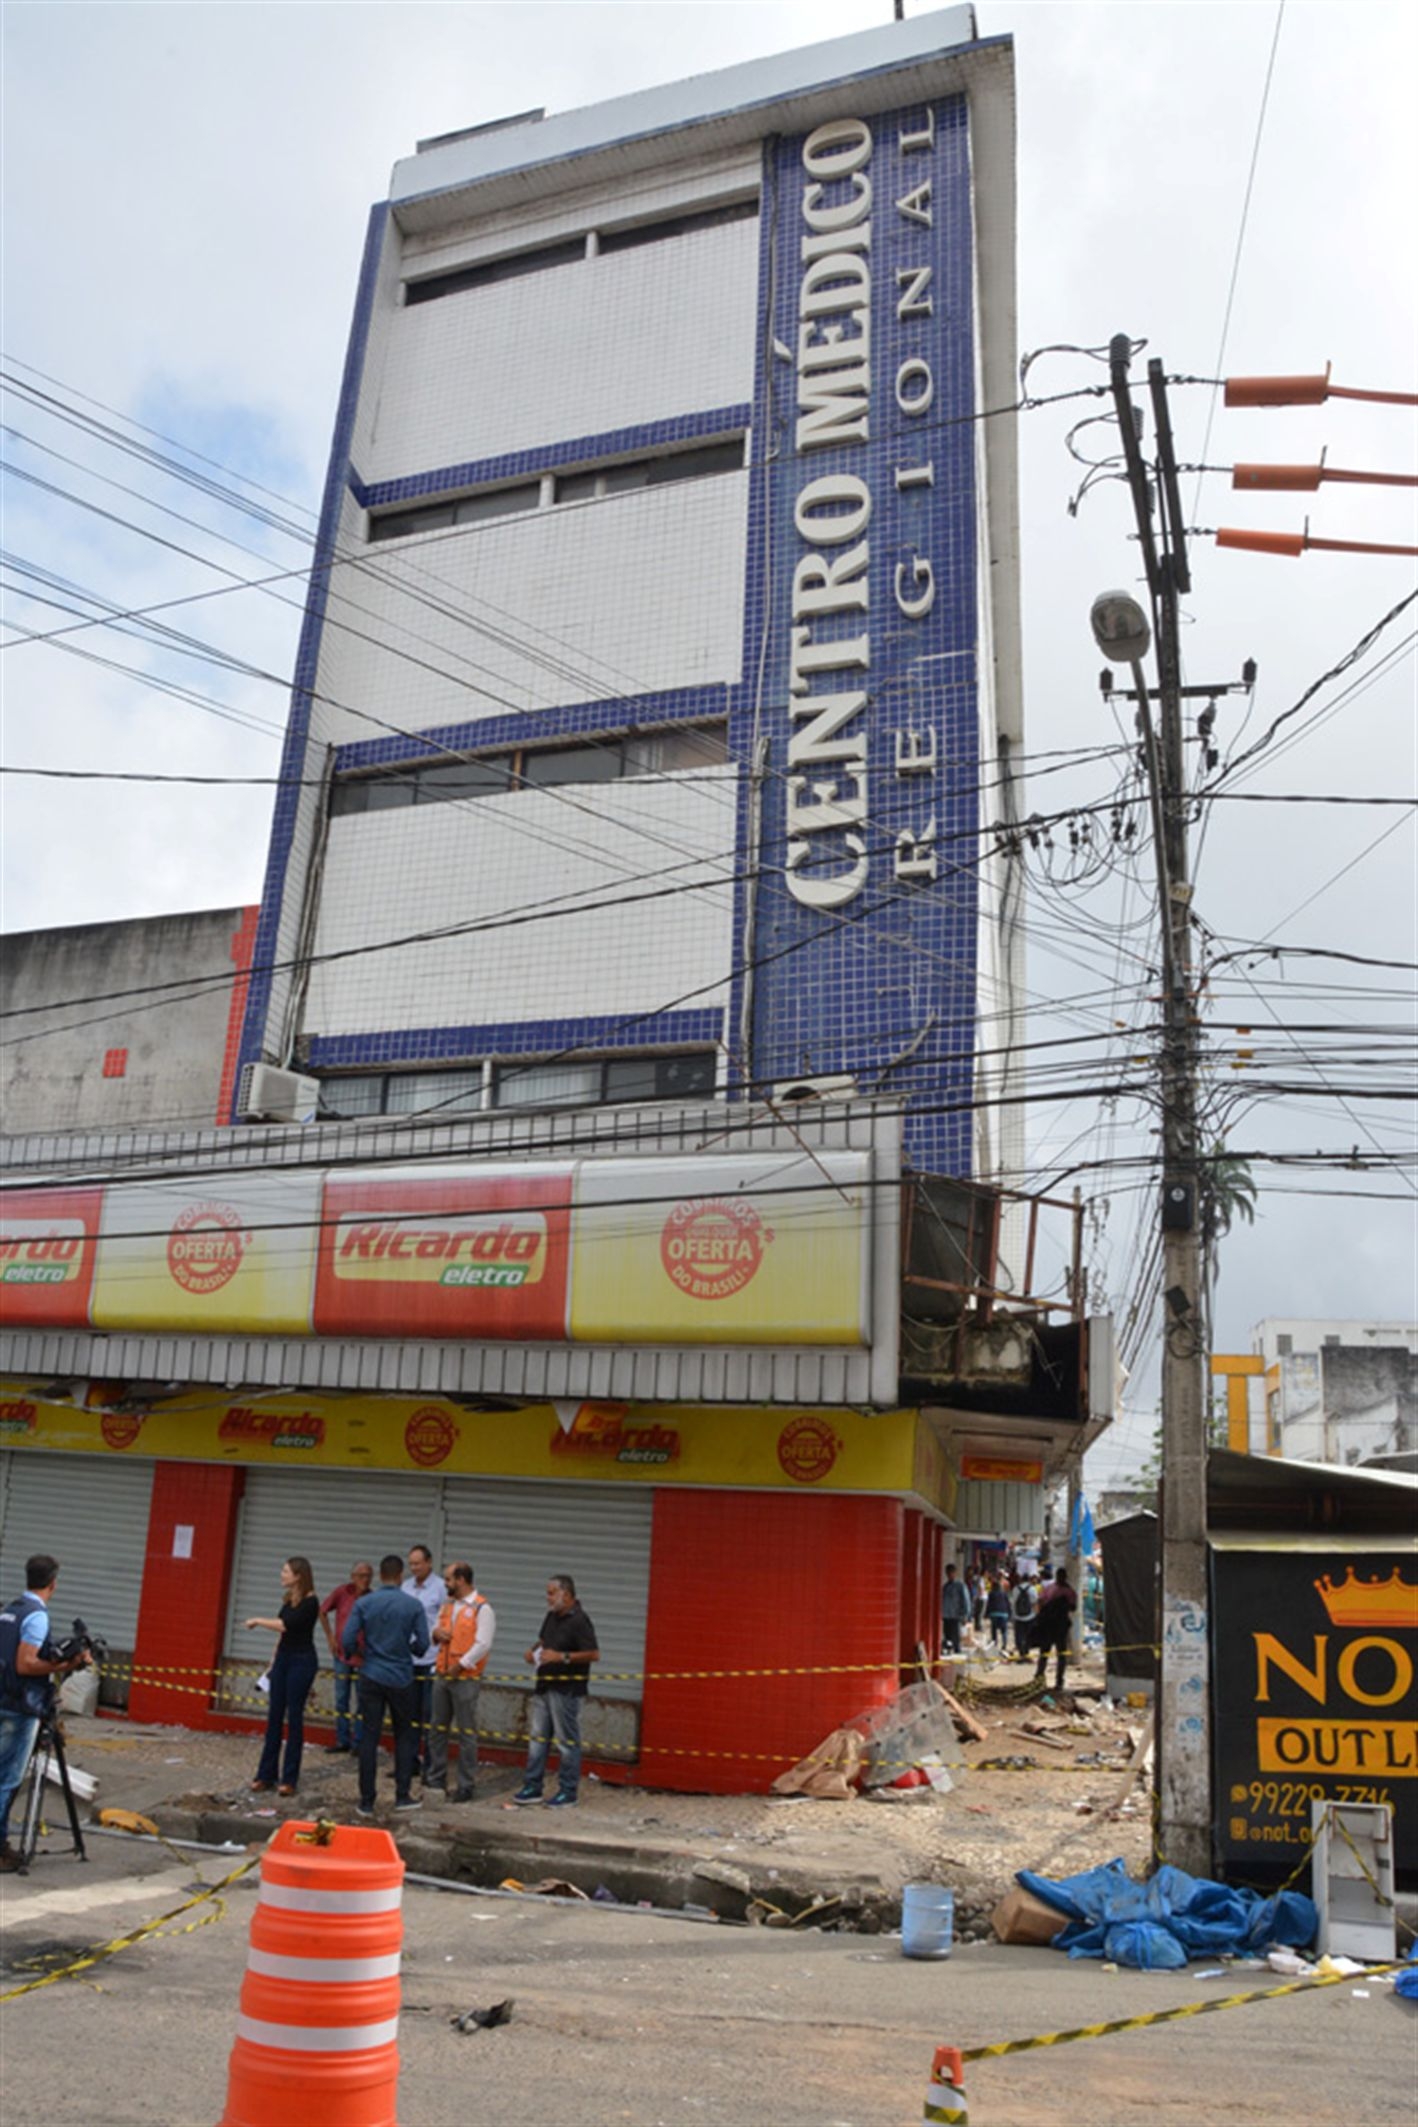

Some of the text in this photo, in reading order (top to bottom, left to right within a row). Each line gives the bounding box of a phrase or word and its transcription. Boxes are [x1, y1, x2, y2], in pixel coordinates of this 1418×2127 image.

[894, 107, 936, 881] REGIONAL
[772, 117, 873, 909] CENTRO MÉDICO
[172, 1240, 236, 1261] OFERTA
[339, 1222, 541, 1261] Ricardo
[667, 1237, 754, 1261] OFERTA
[4, 1266, 66, 1281] eletro
[443, 1265, 524, 1285] eletro
[273, 1435, 316, 1448] eletro
[619, 1449, 668, 1462] eletro
[1252, 1632, 1414, 1707] NO
